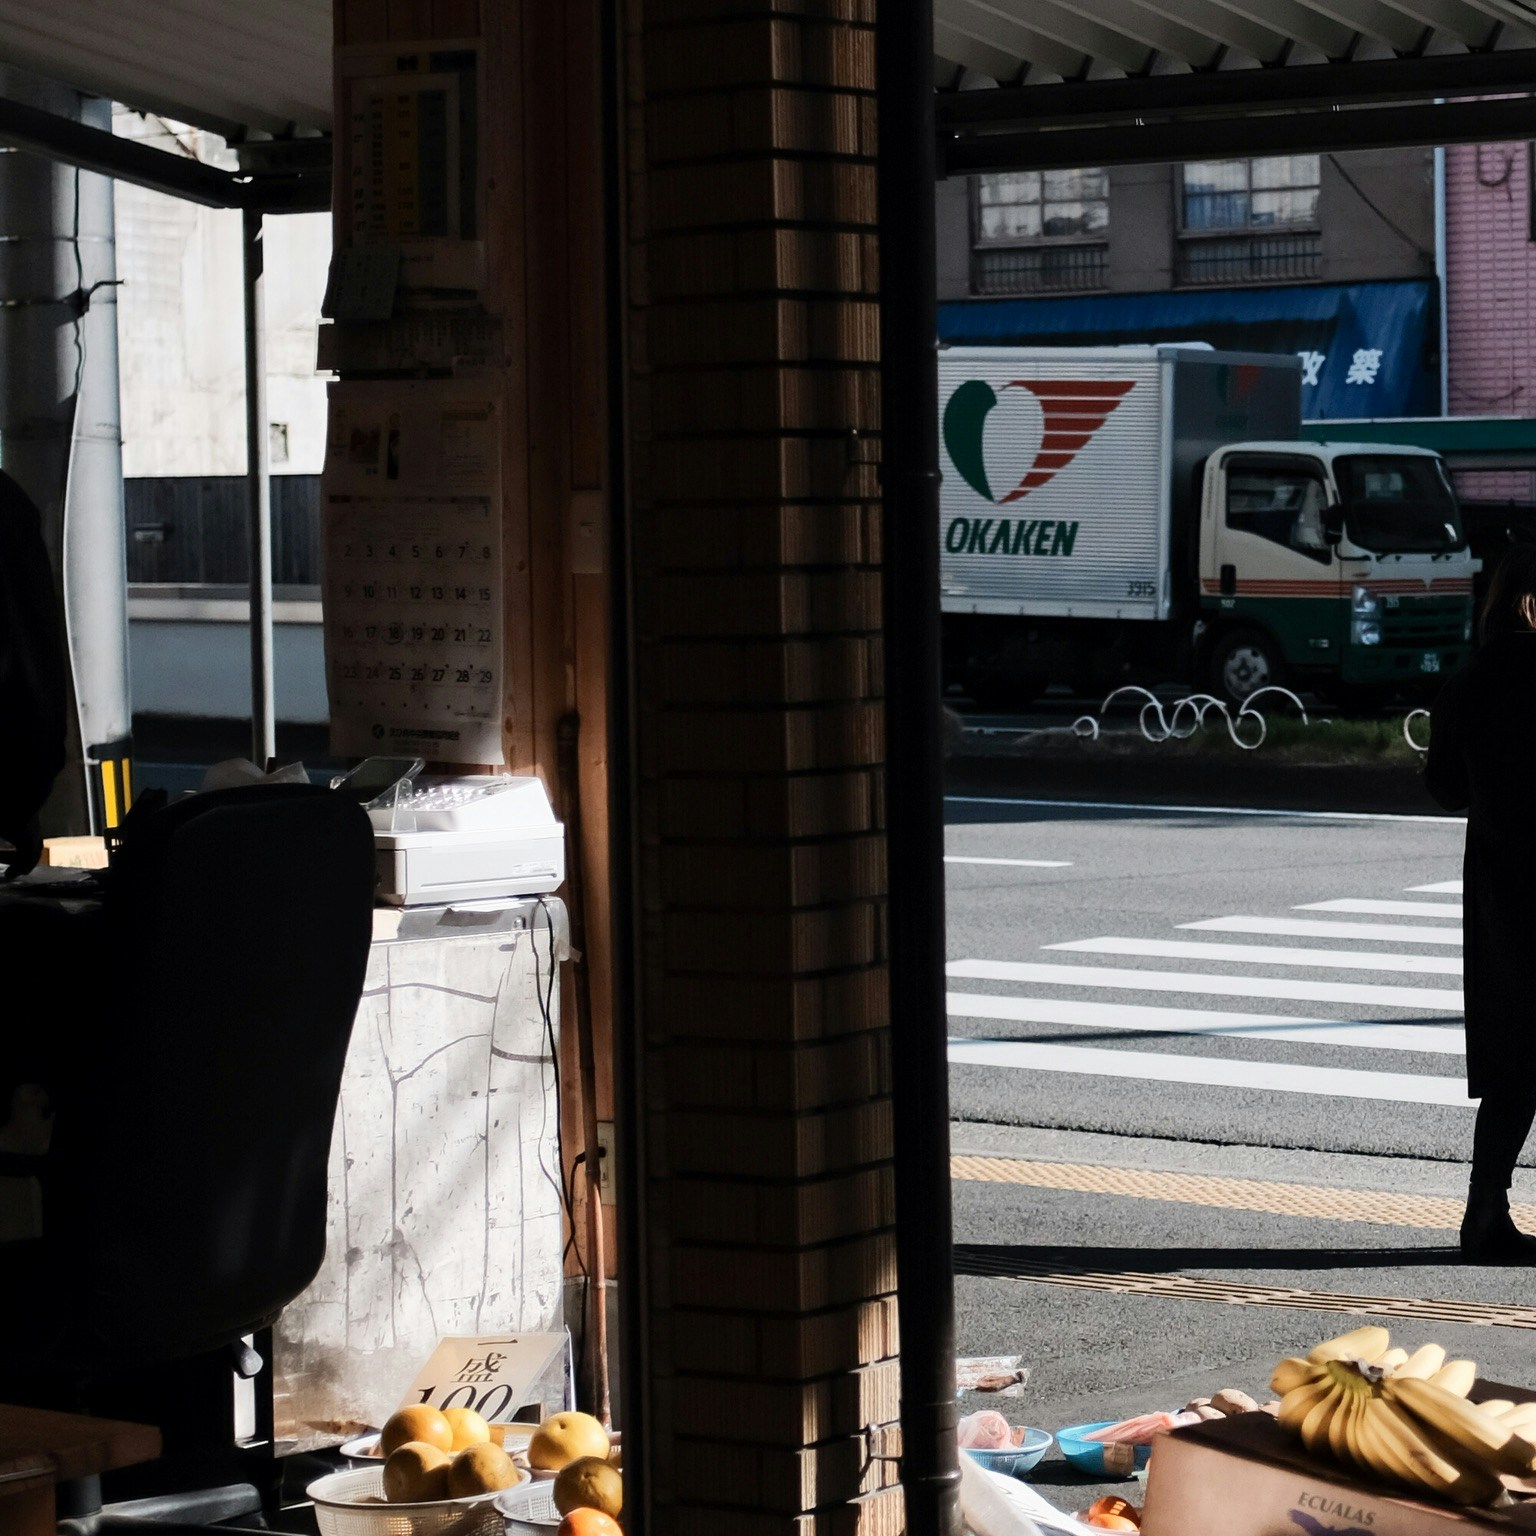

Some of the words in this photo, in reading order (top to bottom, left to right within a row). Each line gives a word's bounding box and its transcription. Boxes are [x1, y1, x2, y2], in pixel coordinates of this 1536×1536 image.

[945, 517, 1080, 557] OKAKEN
[366, 545, 373, 557] 3
[388, 545, 397, 557] 4
[412, 545, 420, 558] 5
[435, 546, 443, 558] 6
[482, 547, 490, 559] 8
[363, 586, 375, 599] 10
[387, 586, 397, 599] 11
[410, 586, 422, 599] 12
[432, 587, 444, 600] 13
[455, 587, 467, 600] 14
[479, 588, 490, 601] 15
[365, 626, 377, 639] 17
[388, 627, 400, 639] 18
[412, 627, 423, 640] 19
[431, 628, 445, 641] 20
[454, 629, 466, 642] 21
[478, 630, 491, 642] 22
[389, 667, 401, 680] 25
[411, 668, 424, 681] 26
[432, 669, 445, 682] 27
[456, 670, 470, 683] 28
[479, 671, 492, 683] 29
[1297, 1491, 1377, 1527] ECUALAS
